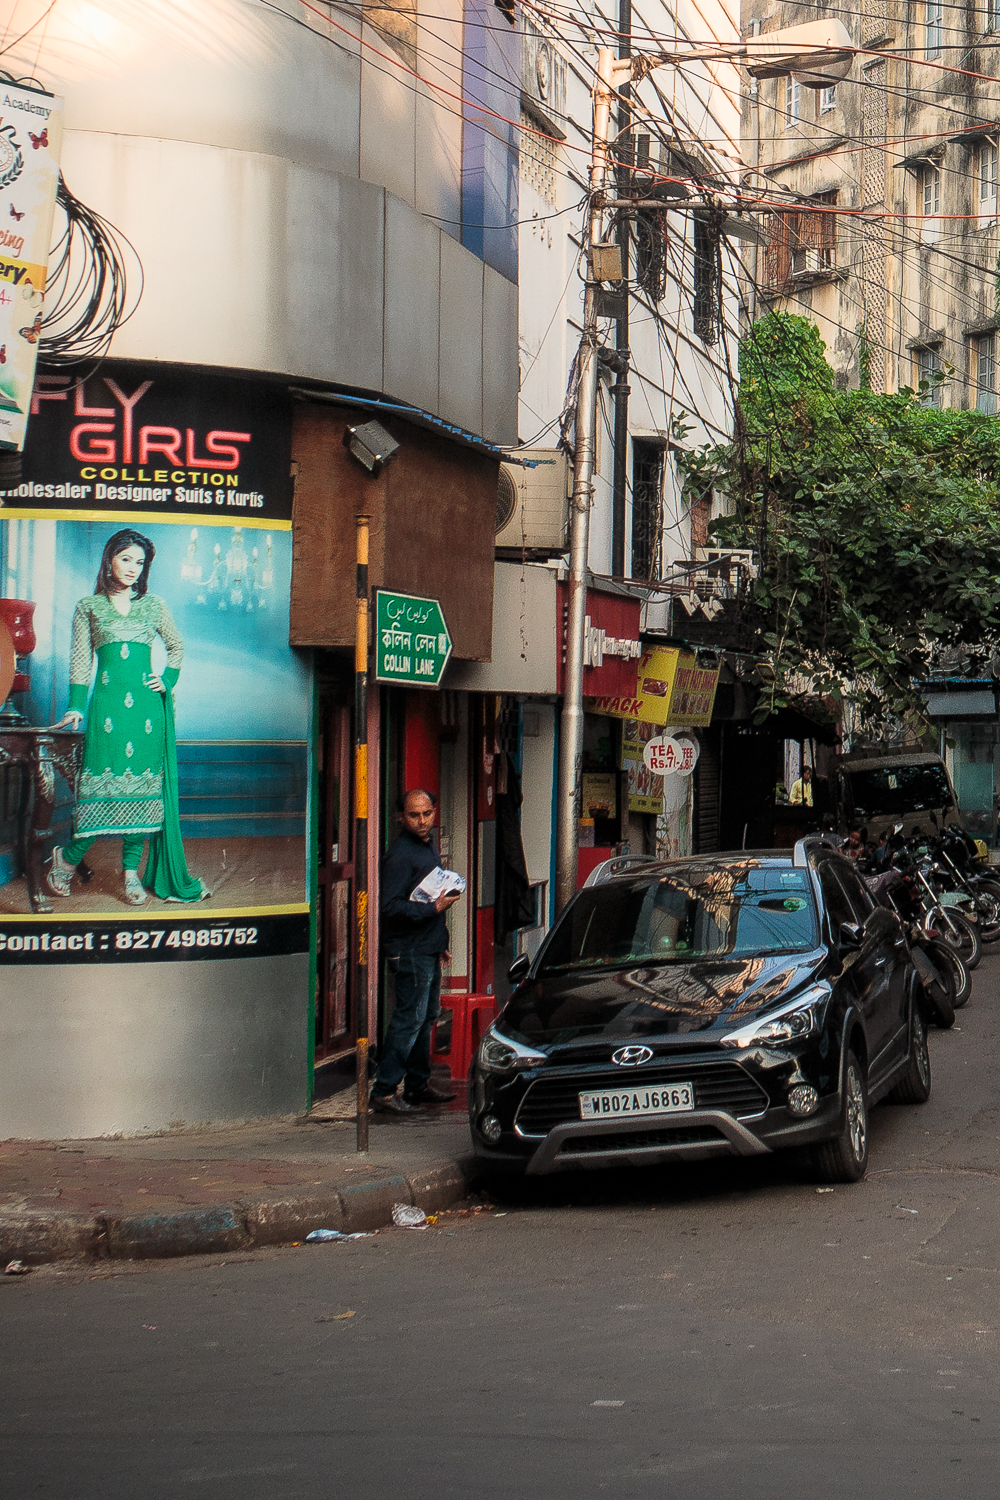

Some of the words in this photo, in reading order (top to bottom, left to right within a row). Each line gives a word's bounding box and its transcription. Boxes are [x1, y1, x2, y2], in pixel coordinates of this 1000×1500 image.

[3, 94, 52, 121] Academy
[31, 374, 154, 438] FLY
[80, 466, 239, 487] COLLECTION
[0, 481, 92, 500] olesaler
[95, 482, 172, 503] Designer
[174, 485, 213, 505] Suits
[215, 487, 225, 505] &
[226, 489, 264, 509] Kurtis
[381, 621, 412, 651] কলিন
[414, 633, 437, 654] লেন
[383, 653, 412, 673] COLLIN
[414, 657, 435, 676] LANE
[650, 745, 674, 756] TEA
[650, 756, 680, 769] Rs.7/-
[114, 927, 258, 950] 8274985752
[591, 1088, 690, 1114] WB02AJ6863
